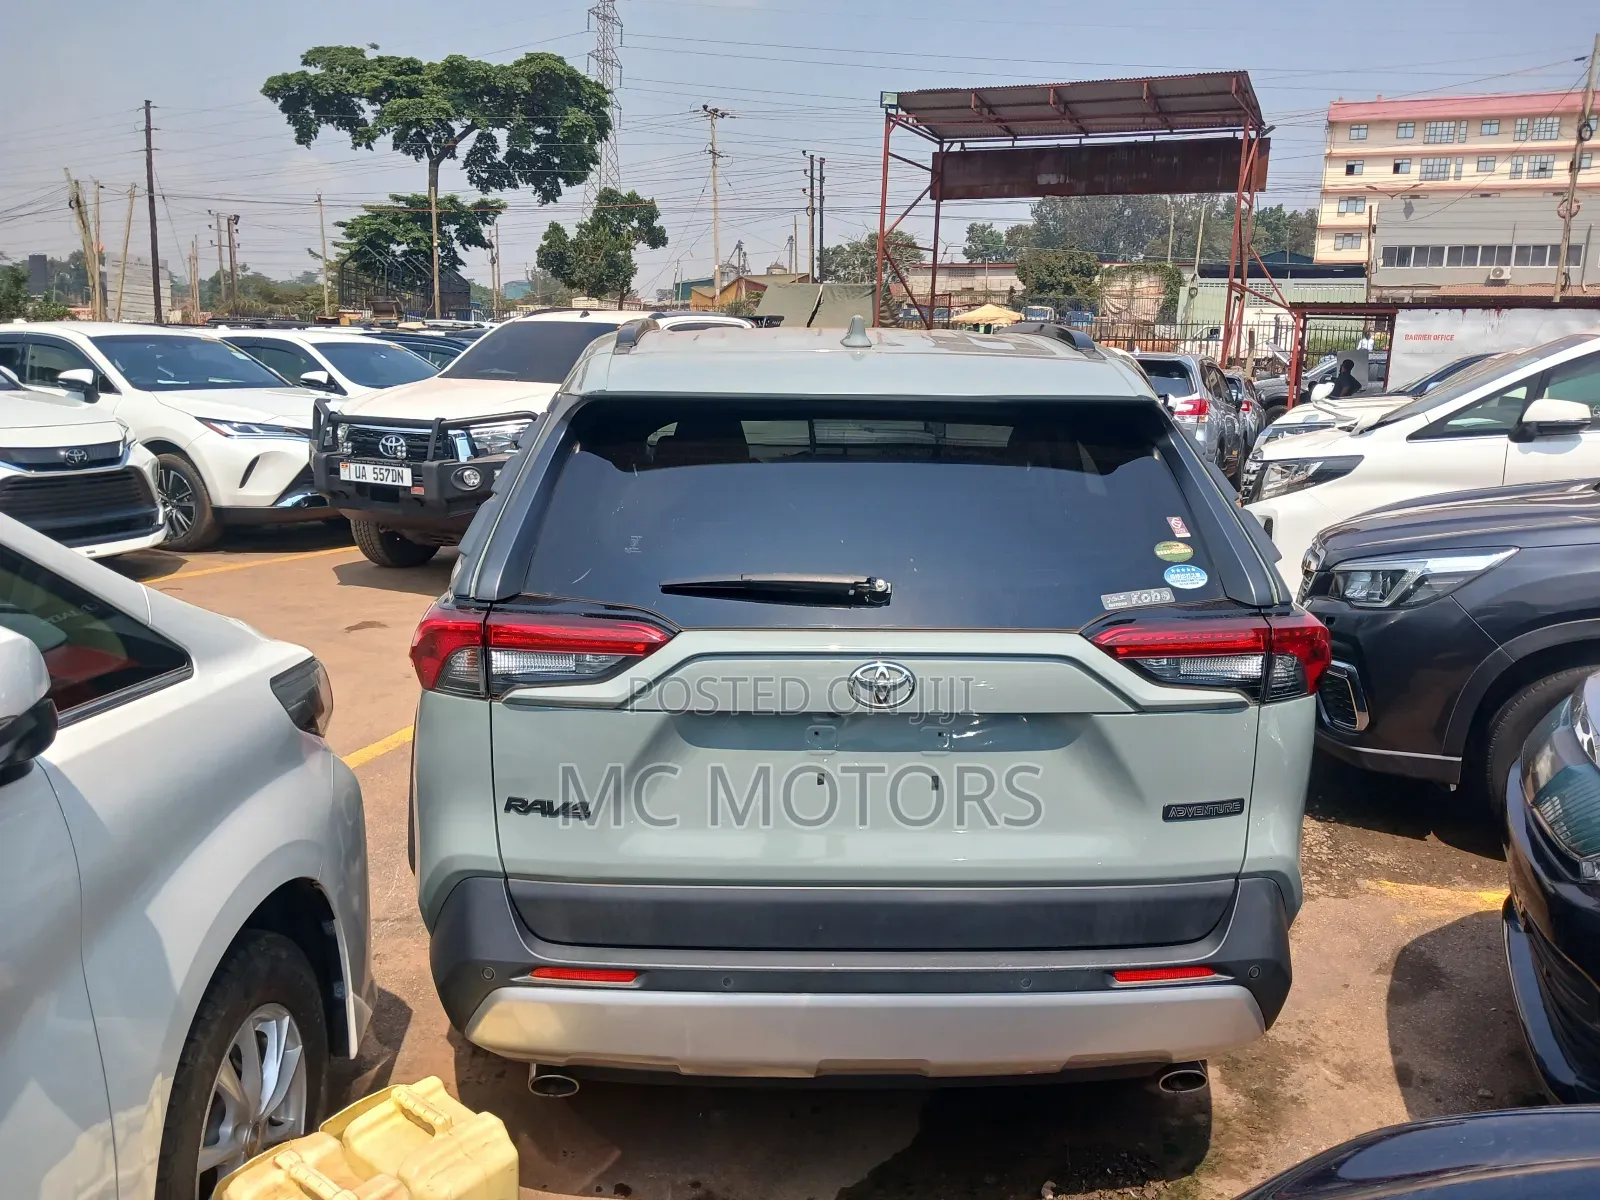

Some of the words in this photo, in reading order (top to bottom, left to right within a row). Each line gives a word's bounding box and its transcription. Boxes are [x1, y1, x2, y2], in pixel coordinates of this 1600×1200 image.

[1404, 333, 1432, 341] BARRIER
[355, 466, 367, 480] UA
[373, 467, 404, 484] 557DN
[504, 796, 591, 820] RAV4
[1168, 801, 1241, 818] ADVENTURE
